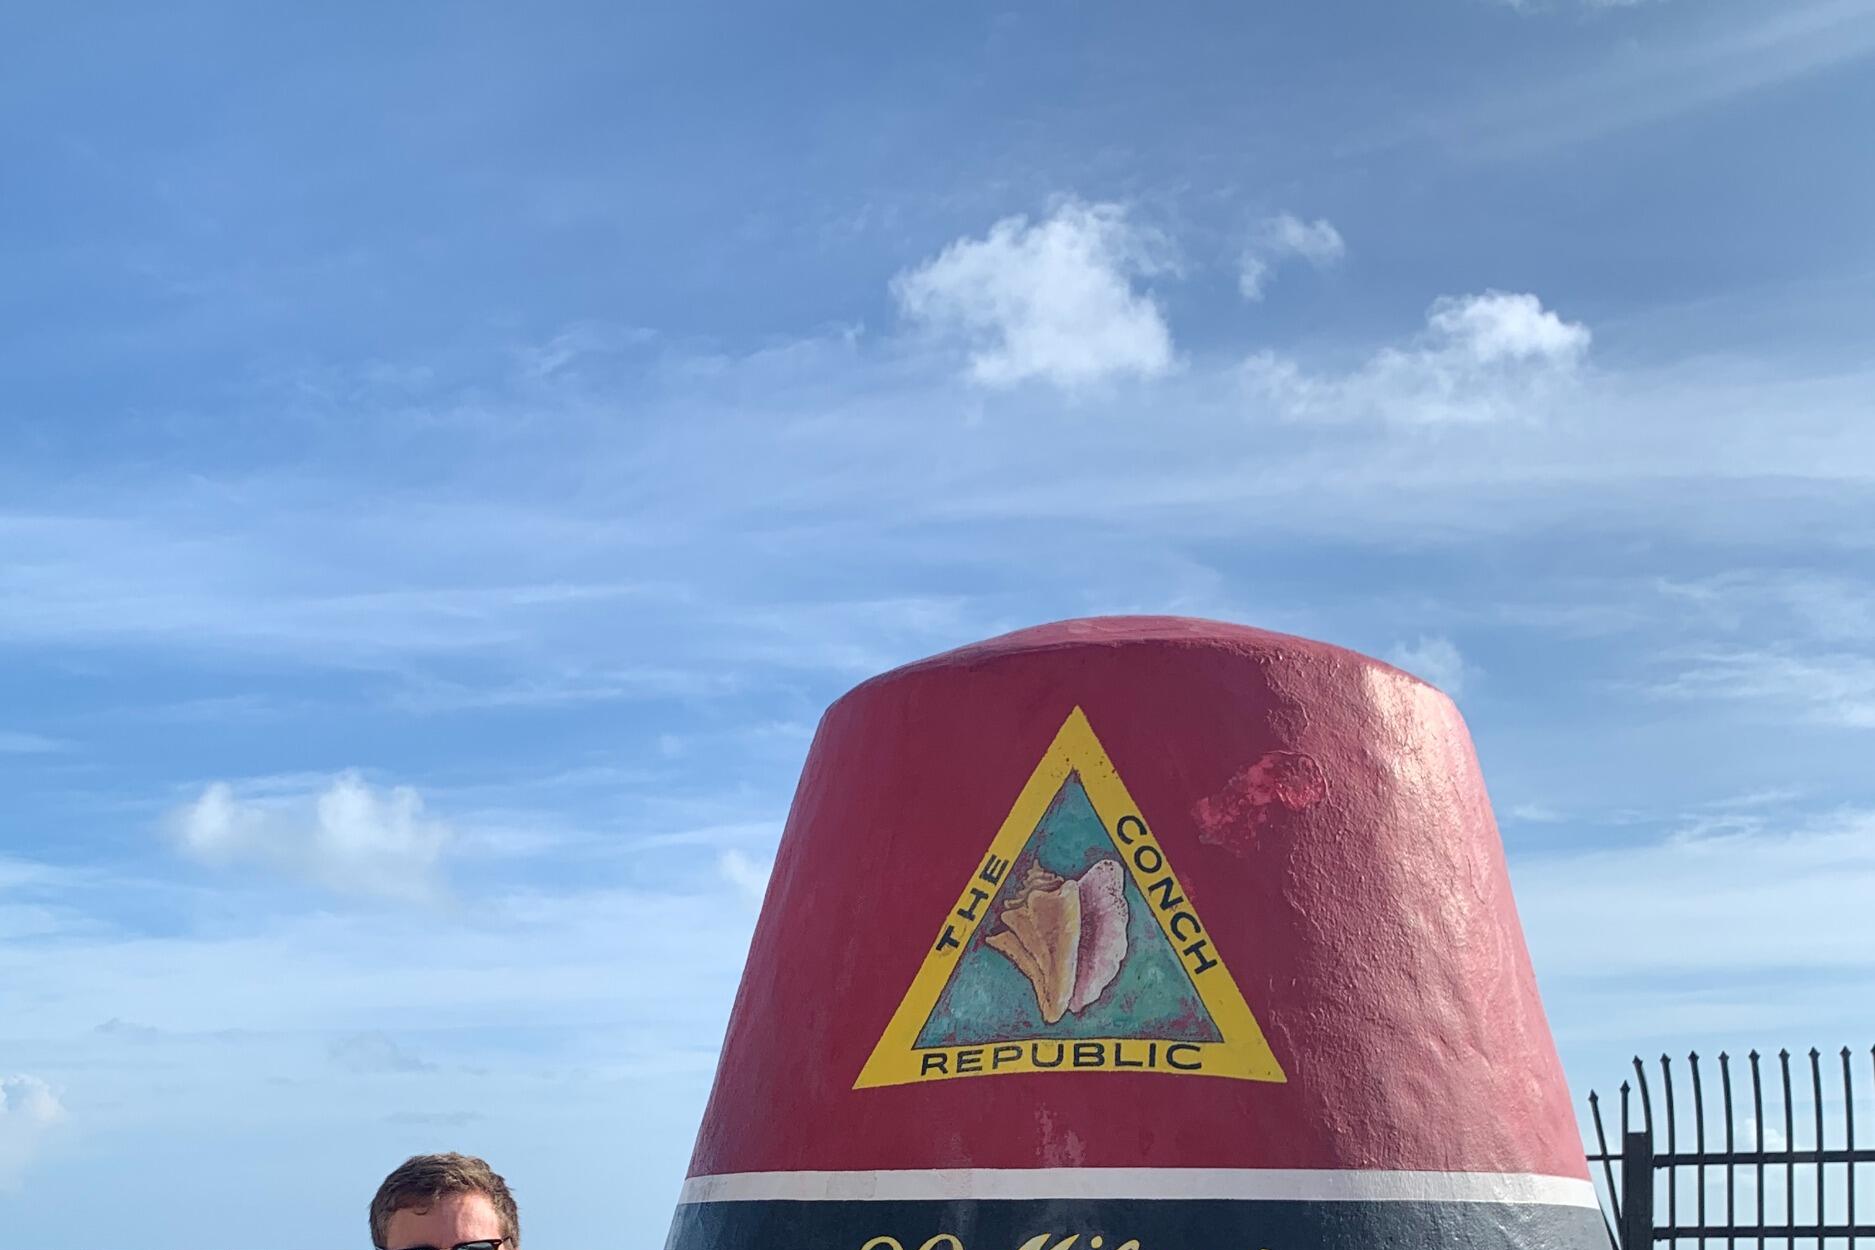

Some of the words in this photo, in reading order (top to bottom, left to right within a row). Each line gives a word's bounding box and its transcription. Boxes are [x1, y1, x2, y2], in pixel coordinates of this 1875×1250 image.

[935, 853, 1010, 954] THE
[1116, 814, 1219, 975] CONCH
[920, 1042, 1203, 1077] REPUBLIC
